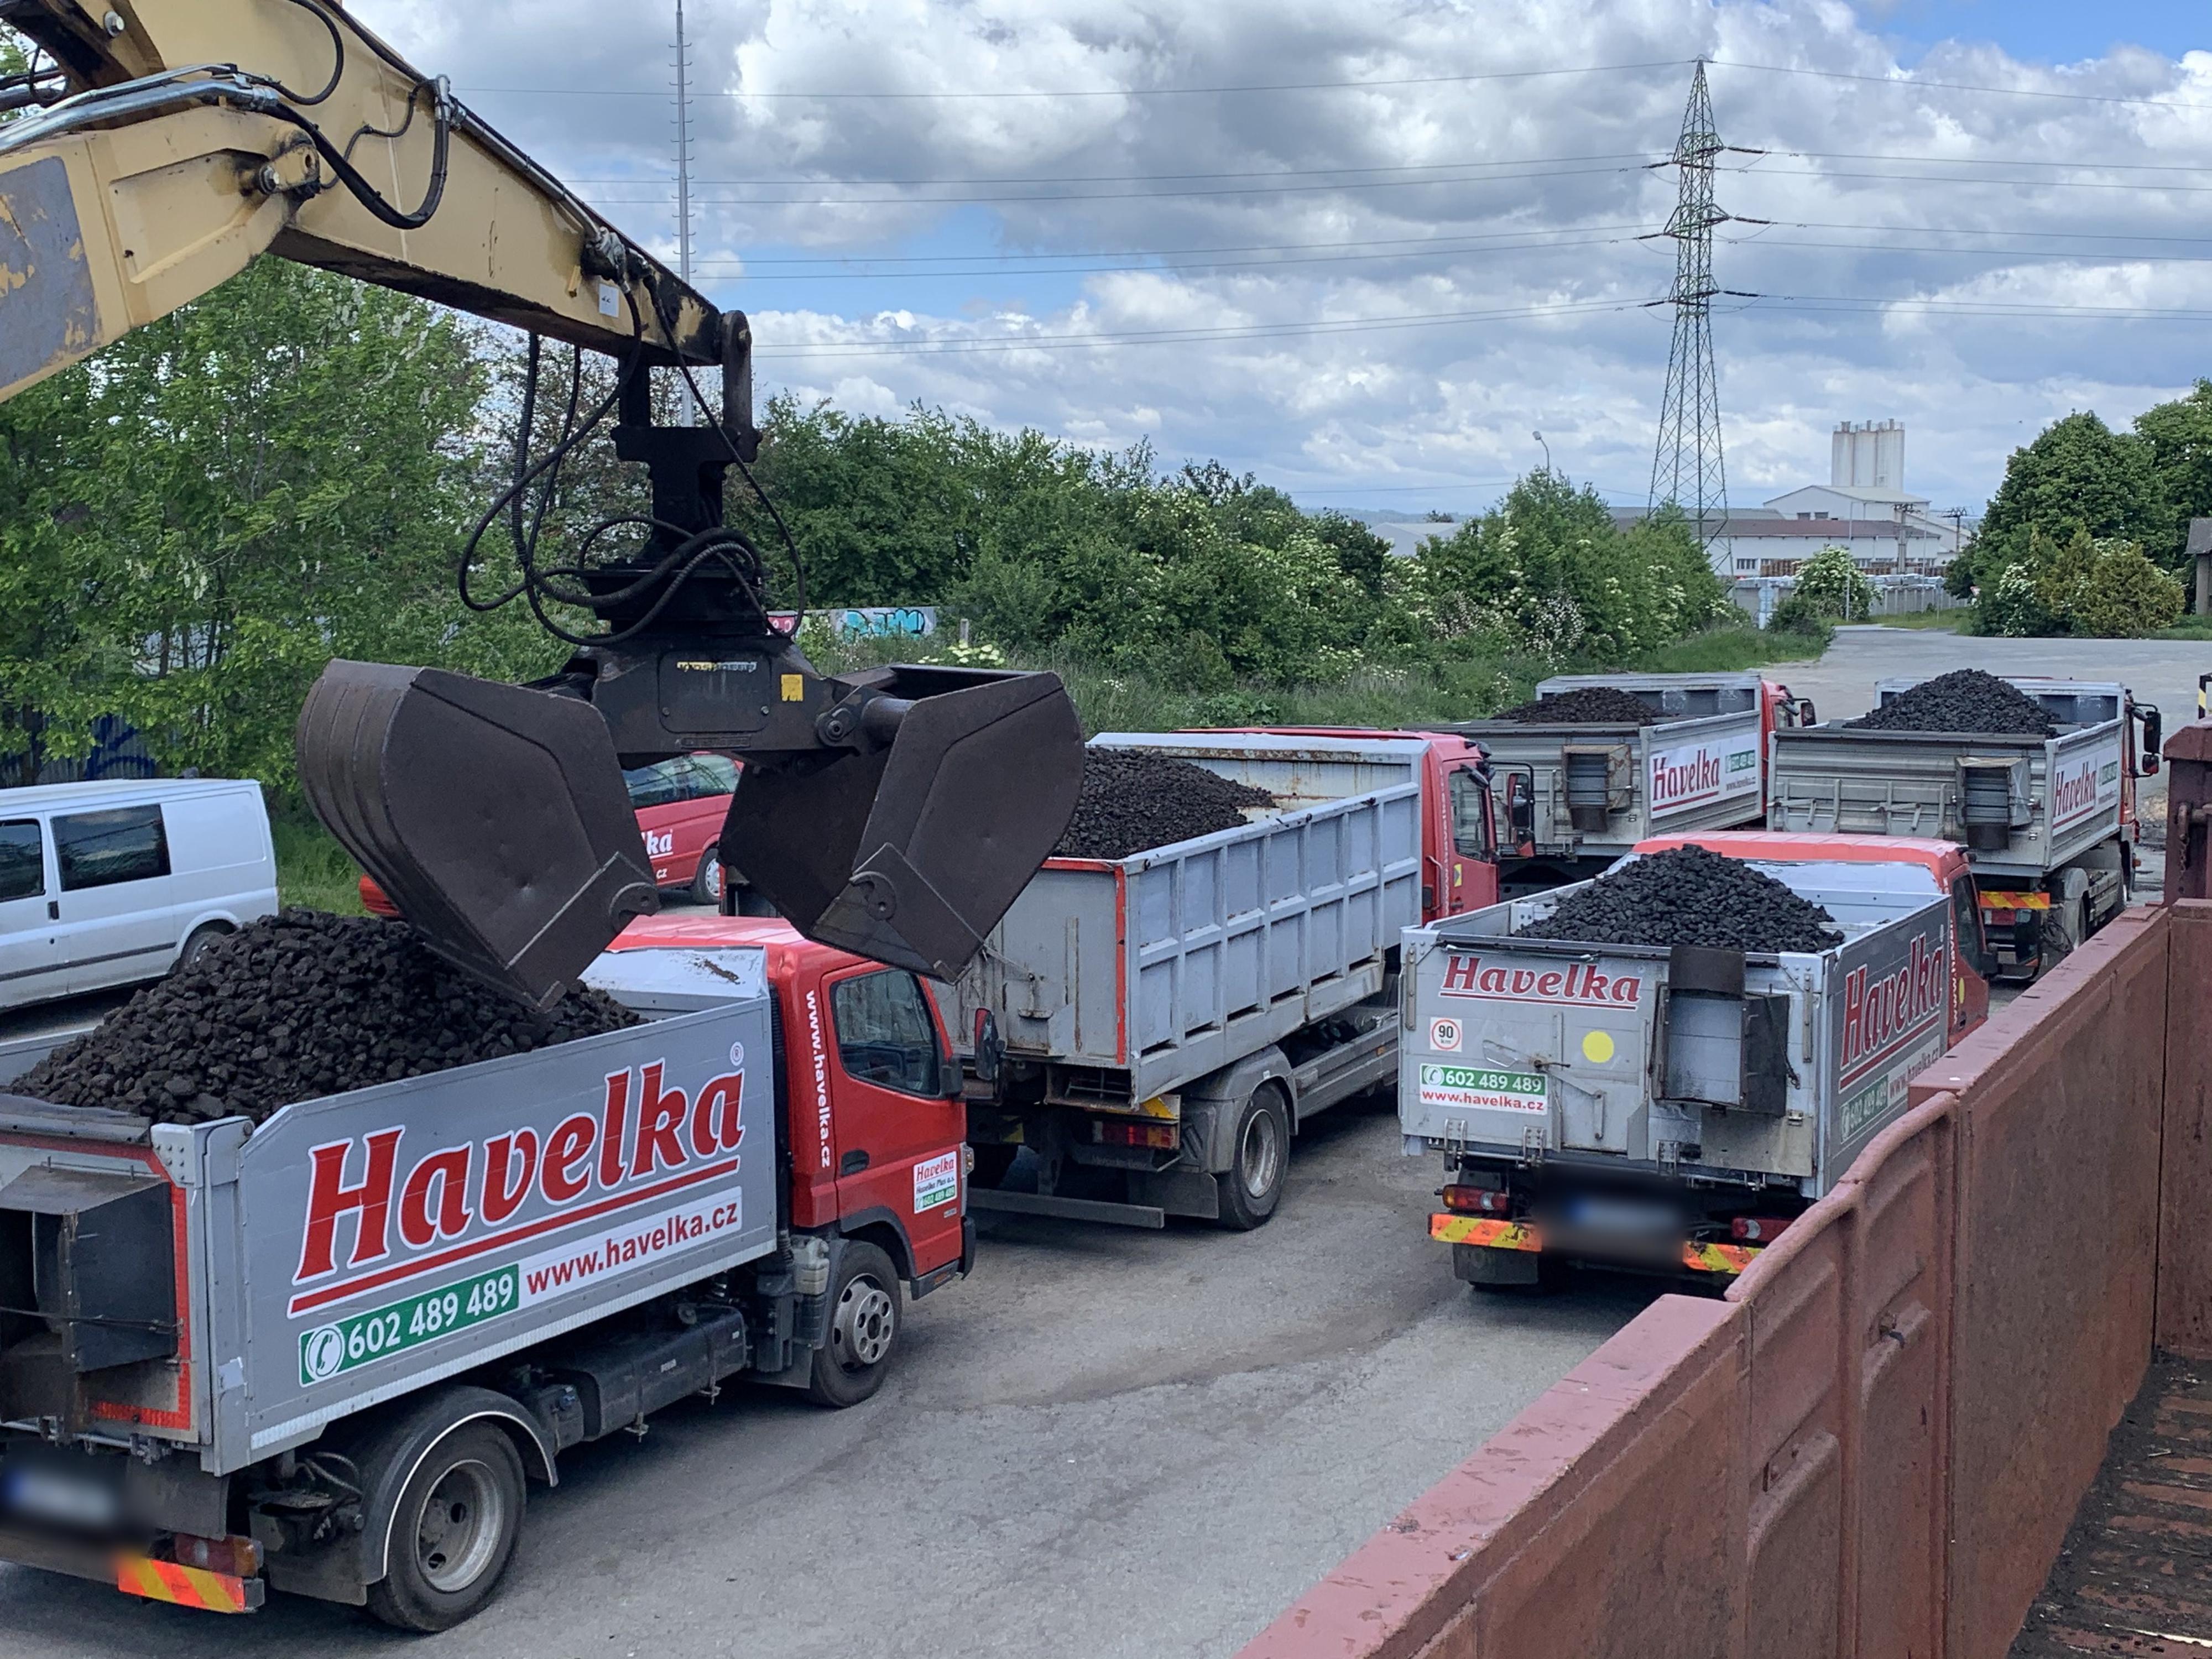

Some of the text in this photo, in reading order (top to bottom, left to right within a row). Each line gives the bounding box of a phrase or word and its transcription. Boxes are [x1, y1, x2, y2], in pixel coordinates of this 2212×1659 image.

[1652, 748, 1720, 801] Havelka
[1441, 954, 1642, 1003] Havelka
[1840, 931, 1944, 1071] Havelka
[1438, 1025, 1454, 1039] 90
[806, 989, 831, 1168] www.havelka.cz
[1422, 1091, 1544, 1110] www.havelka.cz
[1446, 1070, 1542, 1093] 602 489 489
[292, 1057, 745, 1285] Havelka
[916, 1157, 954, 1181] Havelka
[526, 1202, 738, 1295] www.havelka.cz
[347, 1273, 513, 1359] 602 489 489
